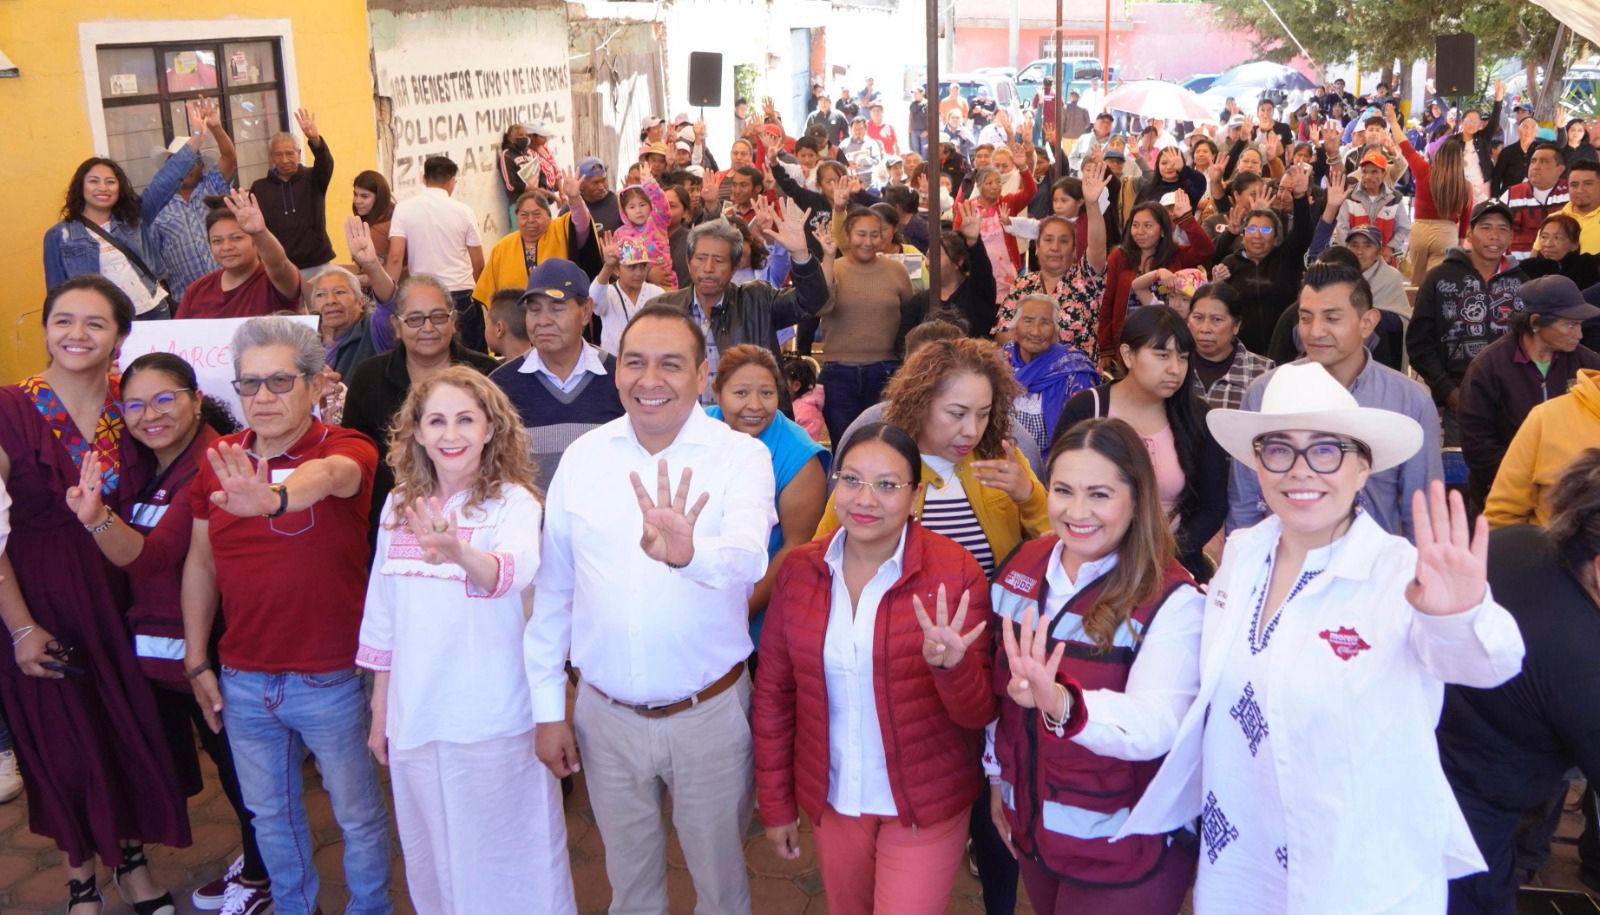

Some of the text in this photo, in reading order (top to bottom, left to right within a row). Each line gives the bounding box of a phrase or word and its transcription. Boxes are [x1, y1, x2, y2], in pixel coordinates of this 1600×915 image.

[411, 69, 474, 106] BIENESTAR
[475, 69, 502, 99] TUYO
[503, 67, 511, 94] Y
[512, 67, 526, 95] DE
[526, 66, 541, 94] LOS
[542, 64, 569, 92] DEMAS
[394, 100, 565, 149] POLICIA MUNICIPAL
